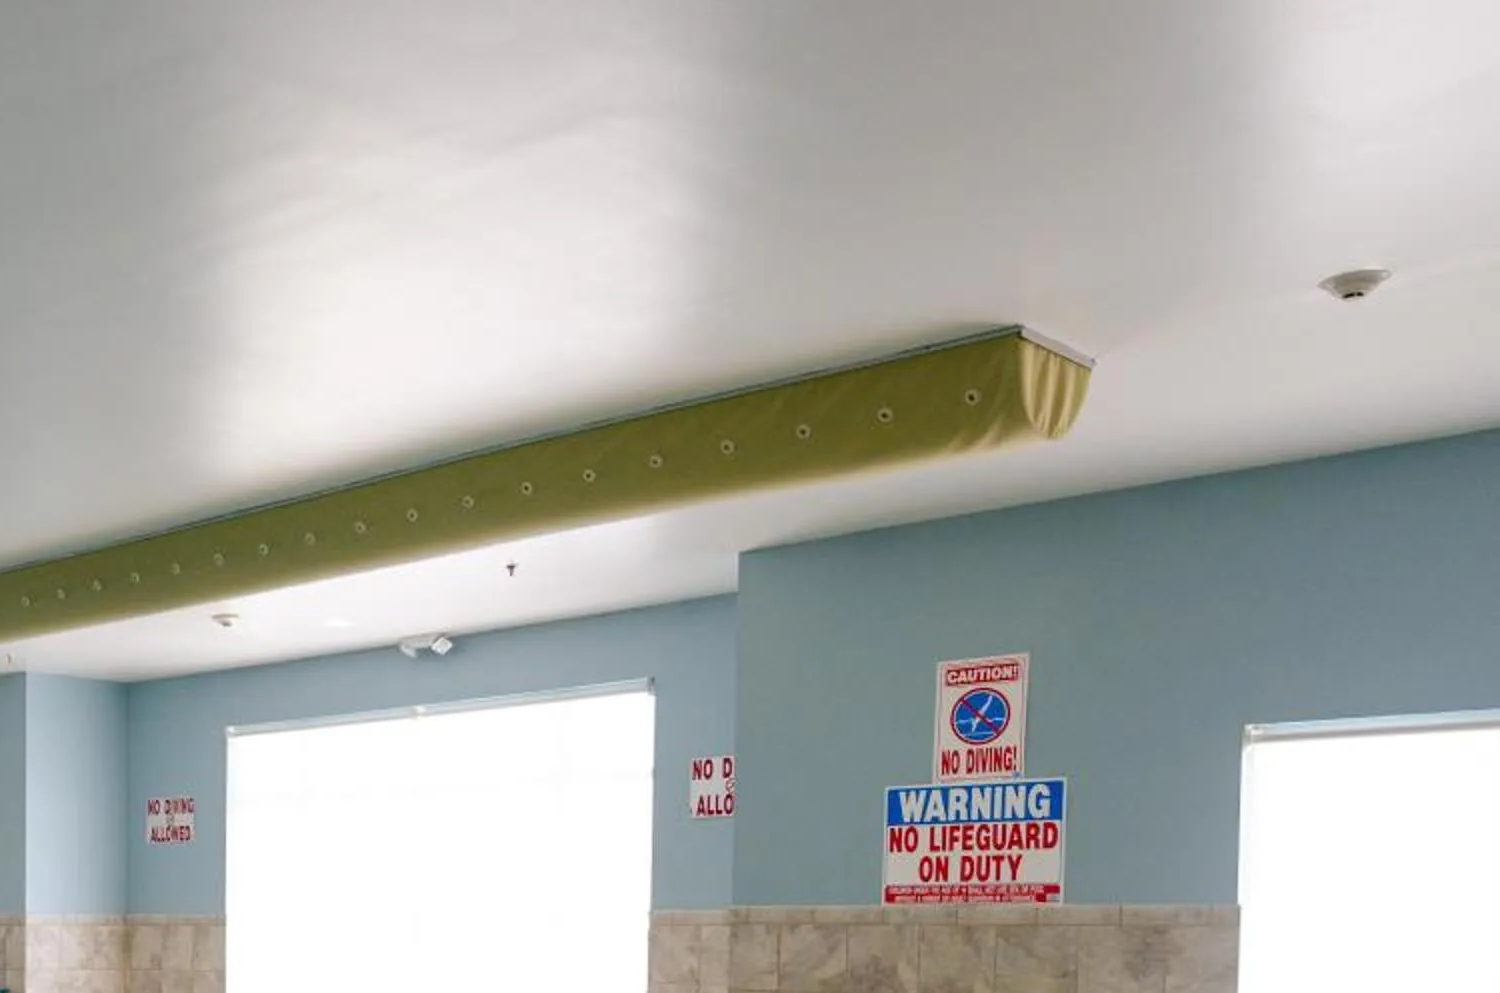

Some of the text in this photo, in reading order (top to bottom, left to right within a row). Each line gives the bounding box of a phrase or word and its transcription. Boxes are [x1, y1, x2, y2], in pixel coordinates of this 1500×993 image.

[947, 664, 1019, 684] CAUTION!
[692, 758, 713, 781] NO
[941, 746, 1018, 776] NO DIVING!
[147, 797, 195, 816] NO DIVING
[899, 783, 1051, 823] WARNING
[151, 825, 191, 842] ALLOWED
[888, 821, 1059, 853] NO LIFEGUARD
[918, 853, 1023, 882] ON DUTY
